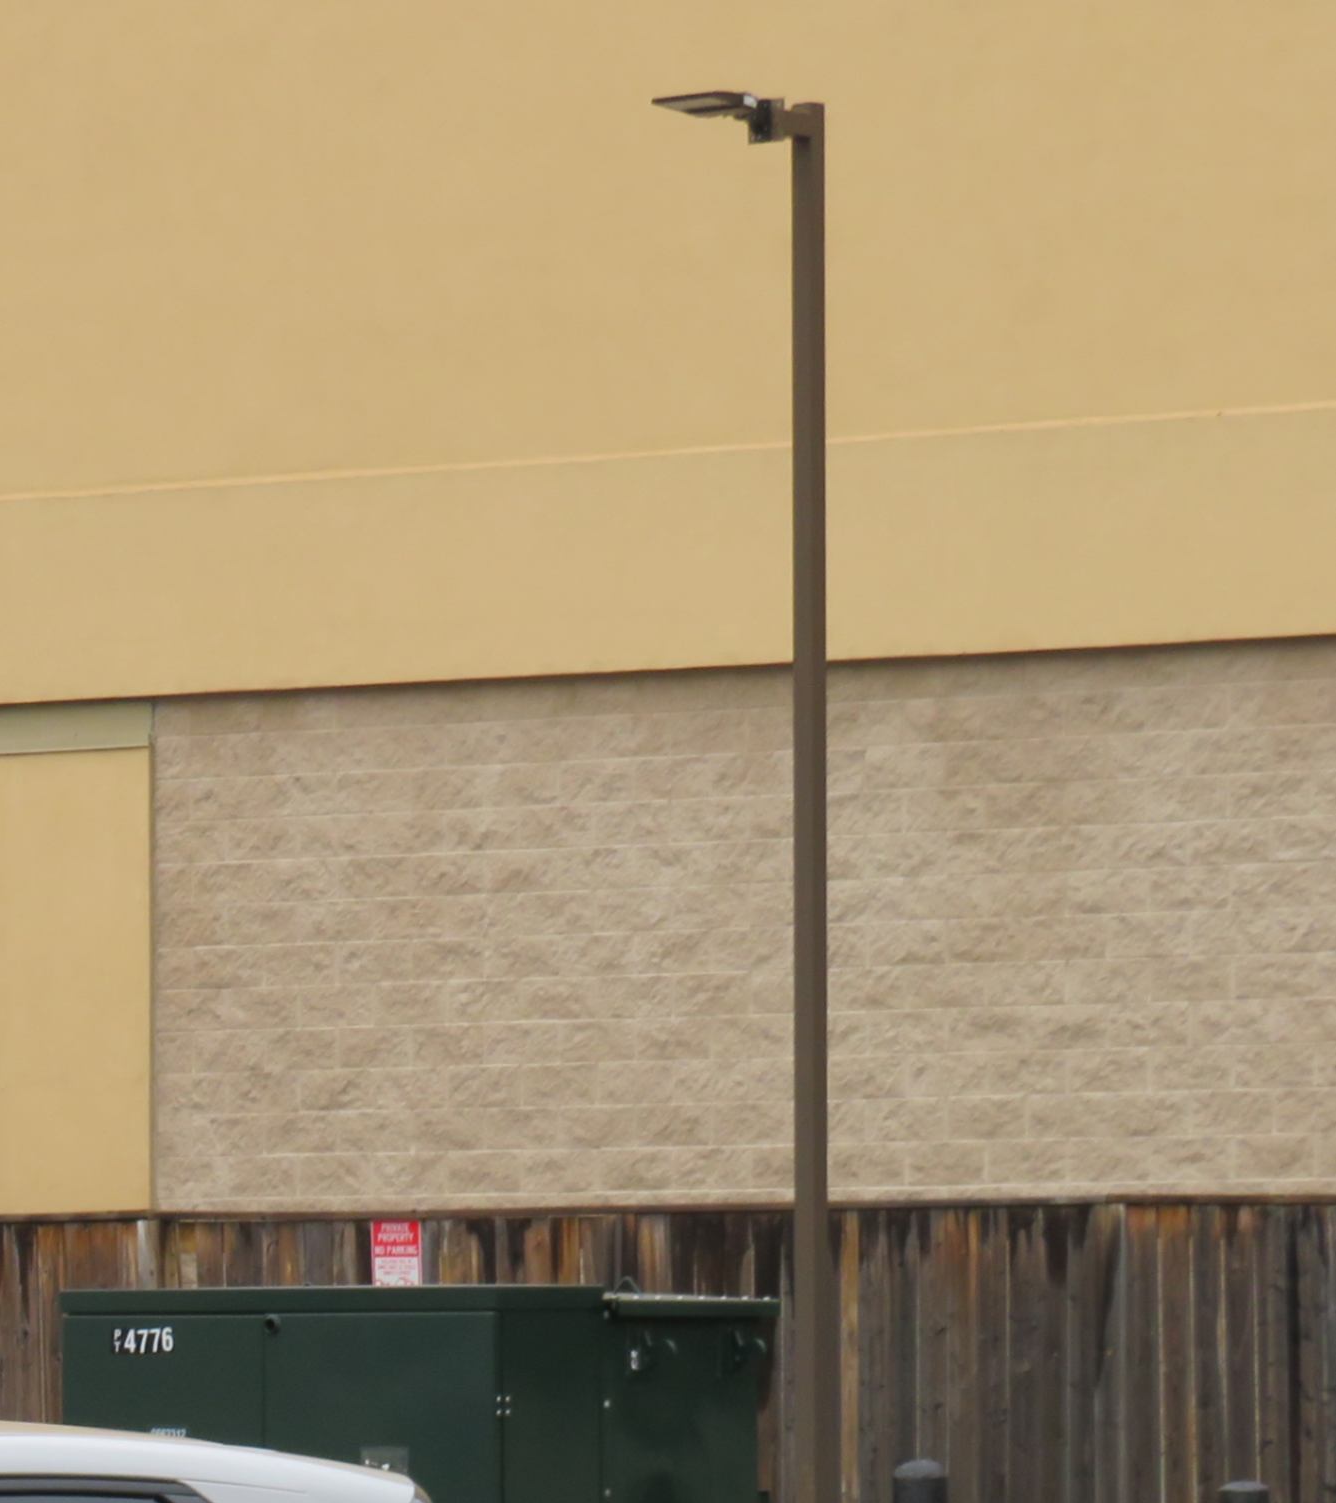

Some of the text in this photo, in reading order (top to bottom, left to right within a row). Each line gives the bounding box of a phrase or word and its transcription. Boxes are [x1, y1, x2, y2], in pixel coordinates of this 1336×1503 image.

[377, 1232, 414, 1242] PROPERTY
[387, 1245, 417, 1255] PARKING
[123, 1326, 174, 1354] 4776
